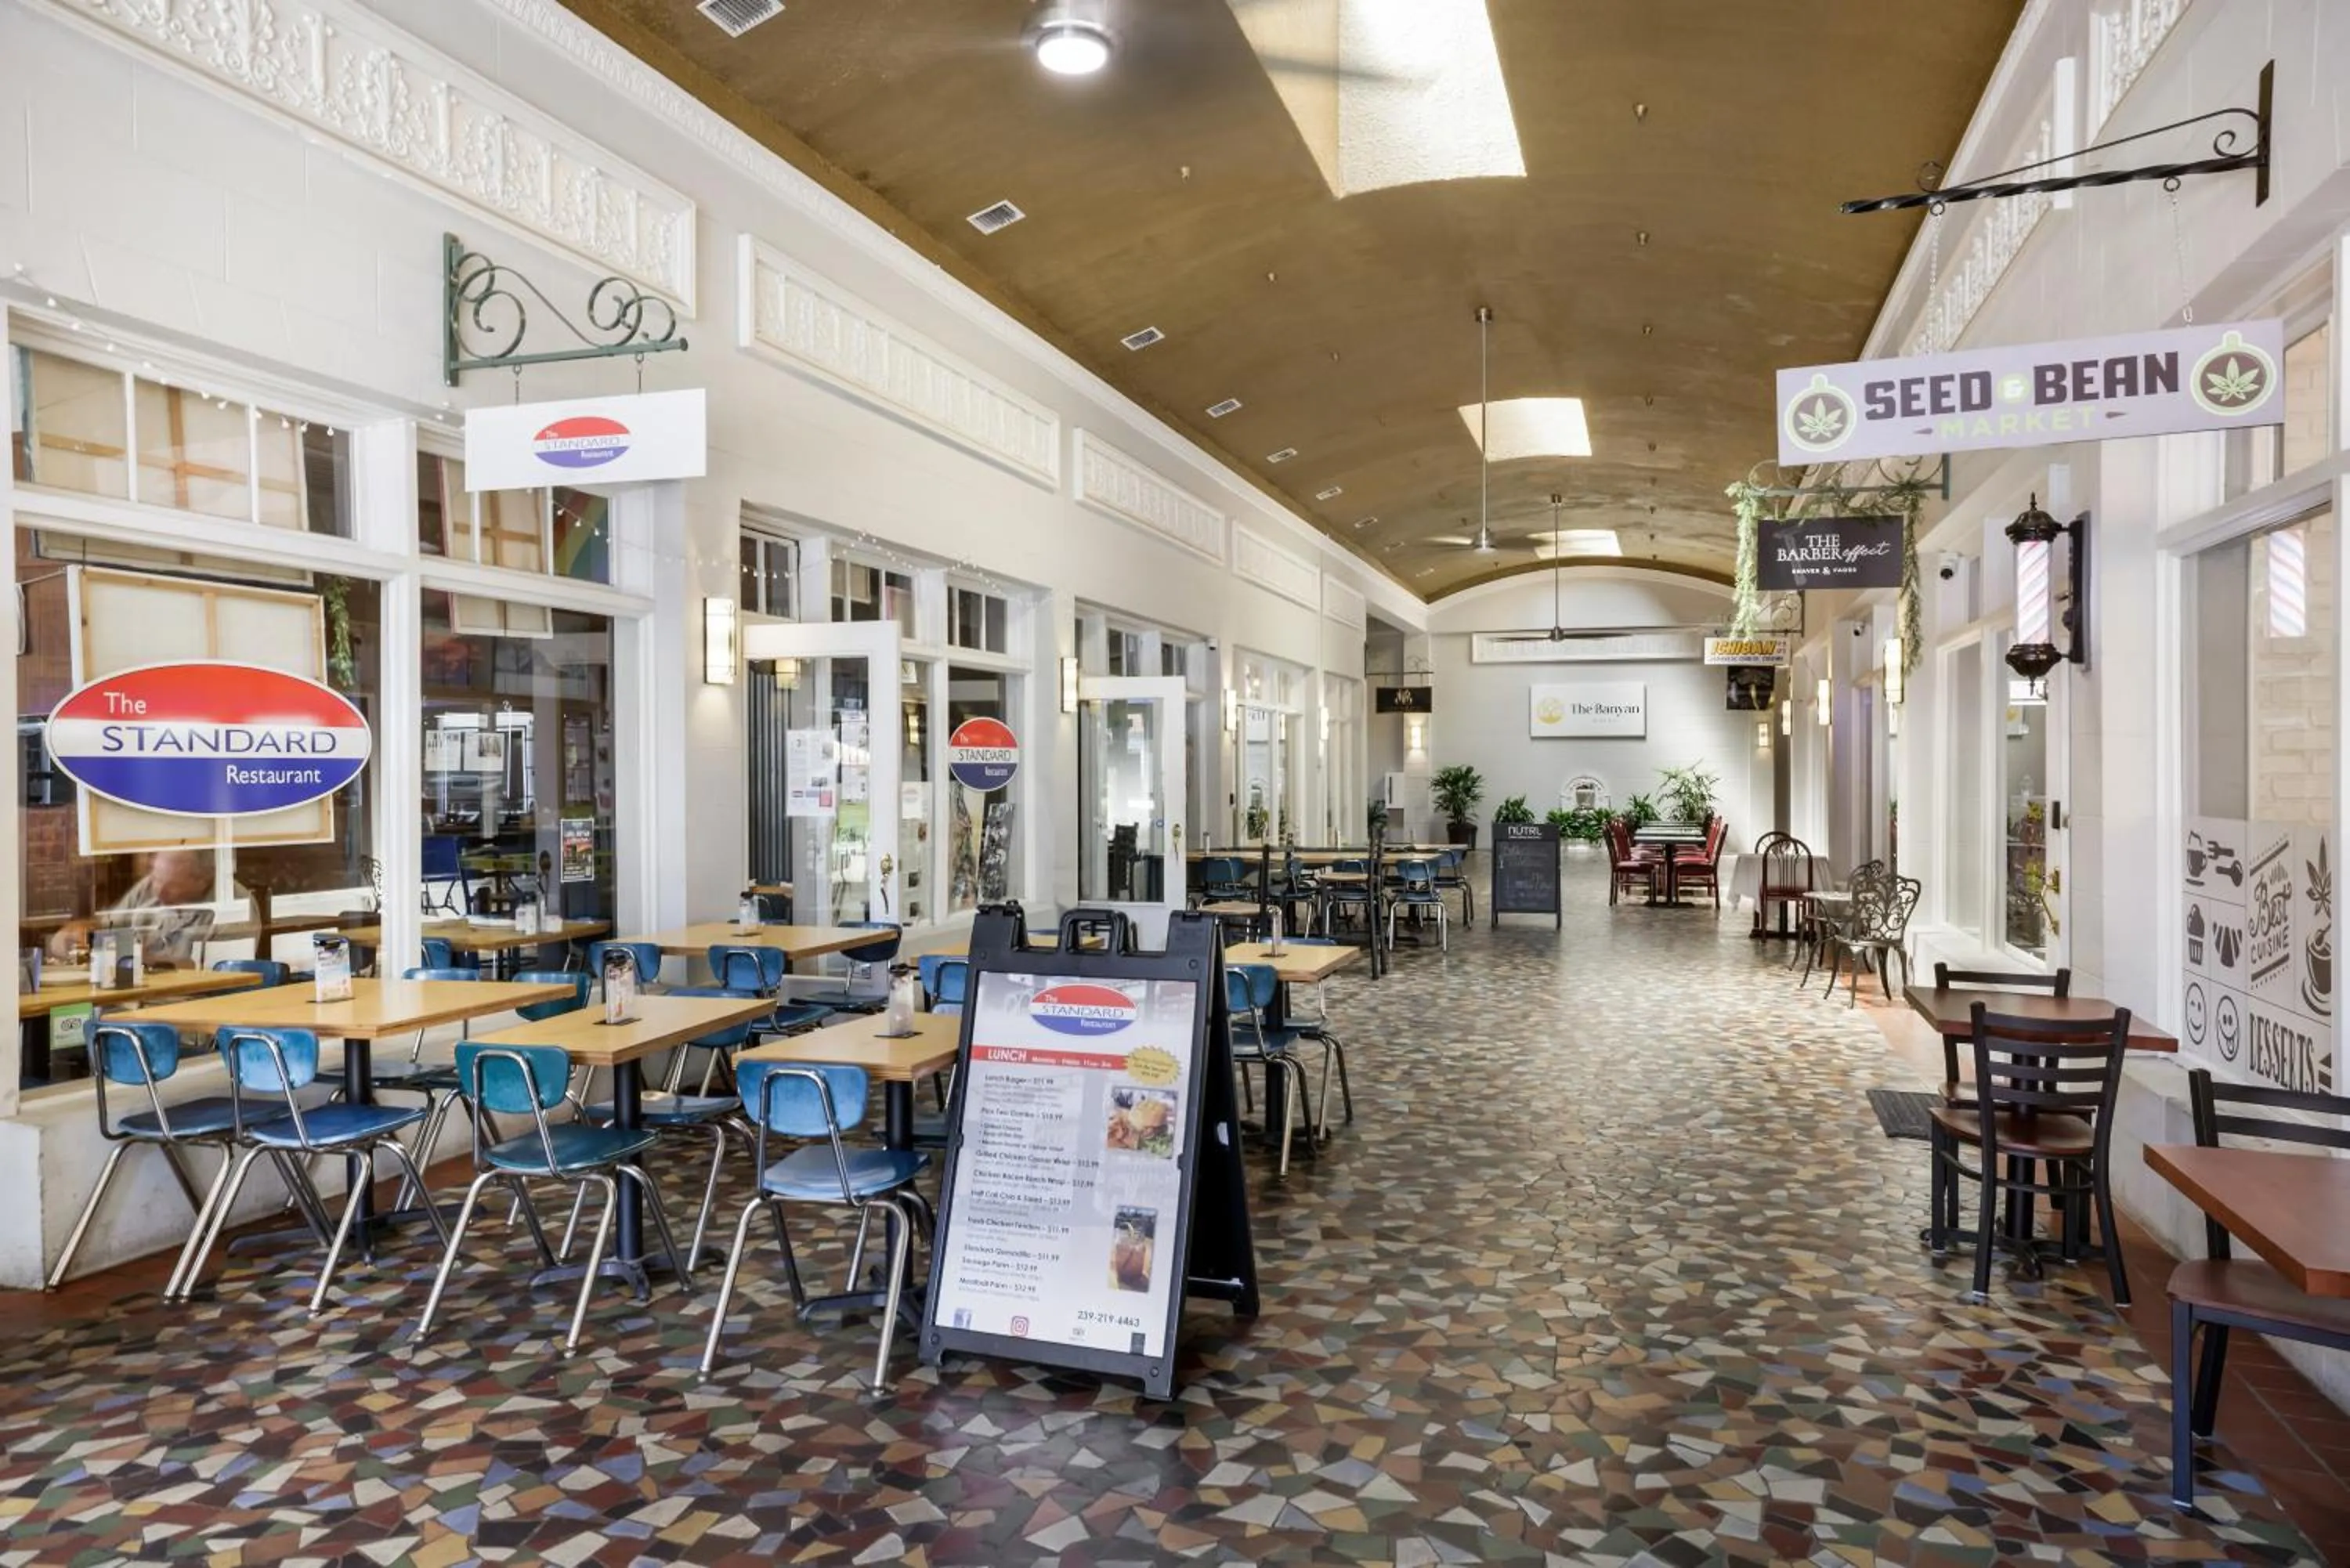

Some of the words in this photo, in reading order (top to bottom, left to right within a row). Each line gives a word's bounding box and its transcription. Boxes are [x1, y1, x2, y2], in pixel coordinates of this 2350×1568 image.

[1864, 370, 1992, 421] SEED
[2034, 352, 2180, 405] BEAN
[1939, 406, 2096, 439] MARKET
[545, 437, 620, 450] STANDARD
[1805, 534, 1841, 547] THE
[1777, 547, 1842, 562] BARBER
[1842, 541, 1891, 563] effect
[1822, 566, 1831, 575] &
[1712, 640, 1777, 655] ICHIBAN
[103, 692, 147, 714] The
[1572, 703, 1593, 714] The
[1596, 703, 1640, 717] Banyan
[102, 726, 337, 753] STANDARD
[958, 749, 1011, 761] STANDARD
[226, 764, 322, 784] Restaurant
[2248, 872, 2292, 938] Best
[2251, 925, 2290, 965] CUISINE
[1042, 1005, 1124, 1017] STANDARD
[987, 1049, 1027, 1064] LUNCH
[2250, 1012, 2315, 1096] DESSERTS
[975, 1149, 997, 1158] Grilled
[999, 1151, 1026, 1161] Chicken
[974, 1169, 1000, 1178] Chicken
[1003, 1171, 1023, 1180] Bacon
[985, 1218, 1014, 1227] Chicken
